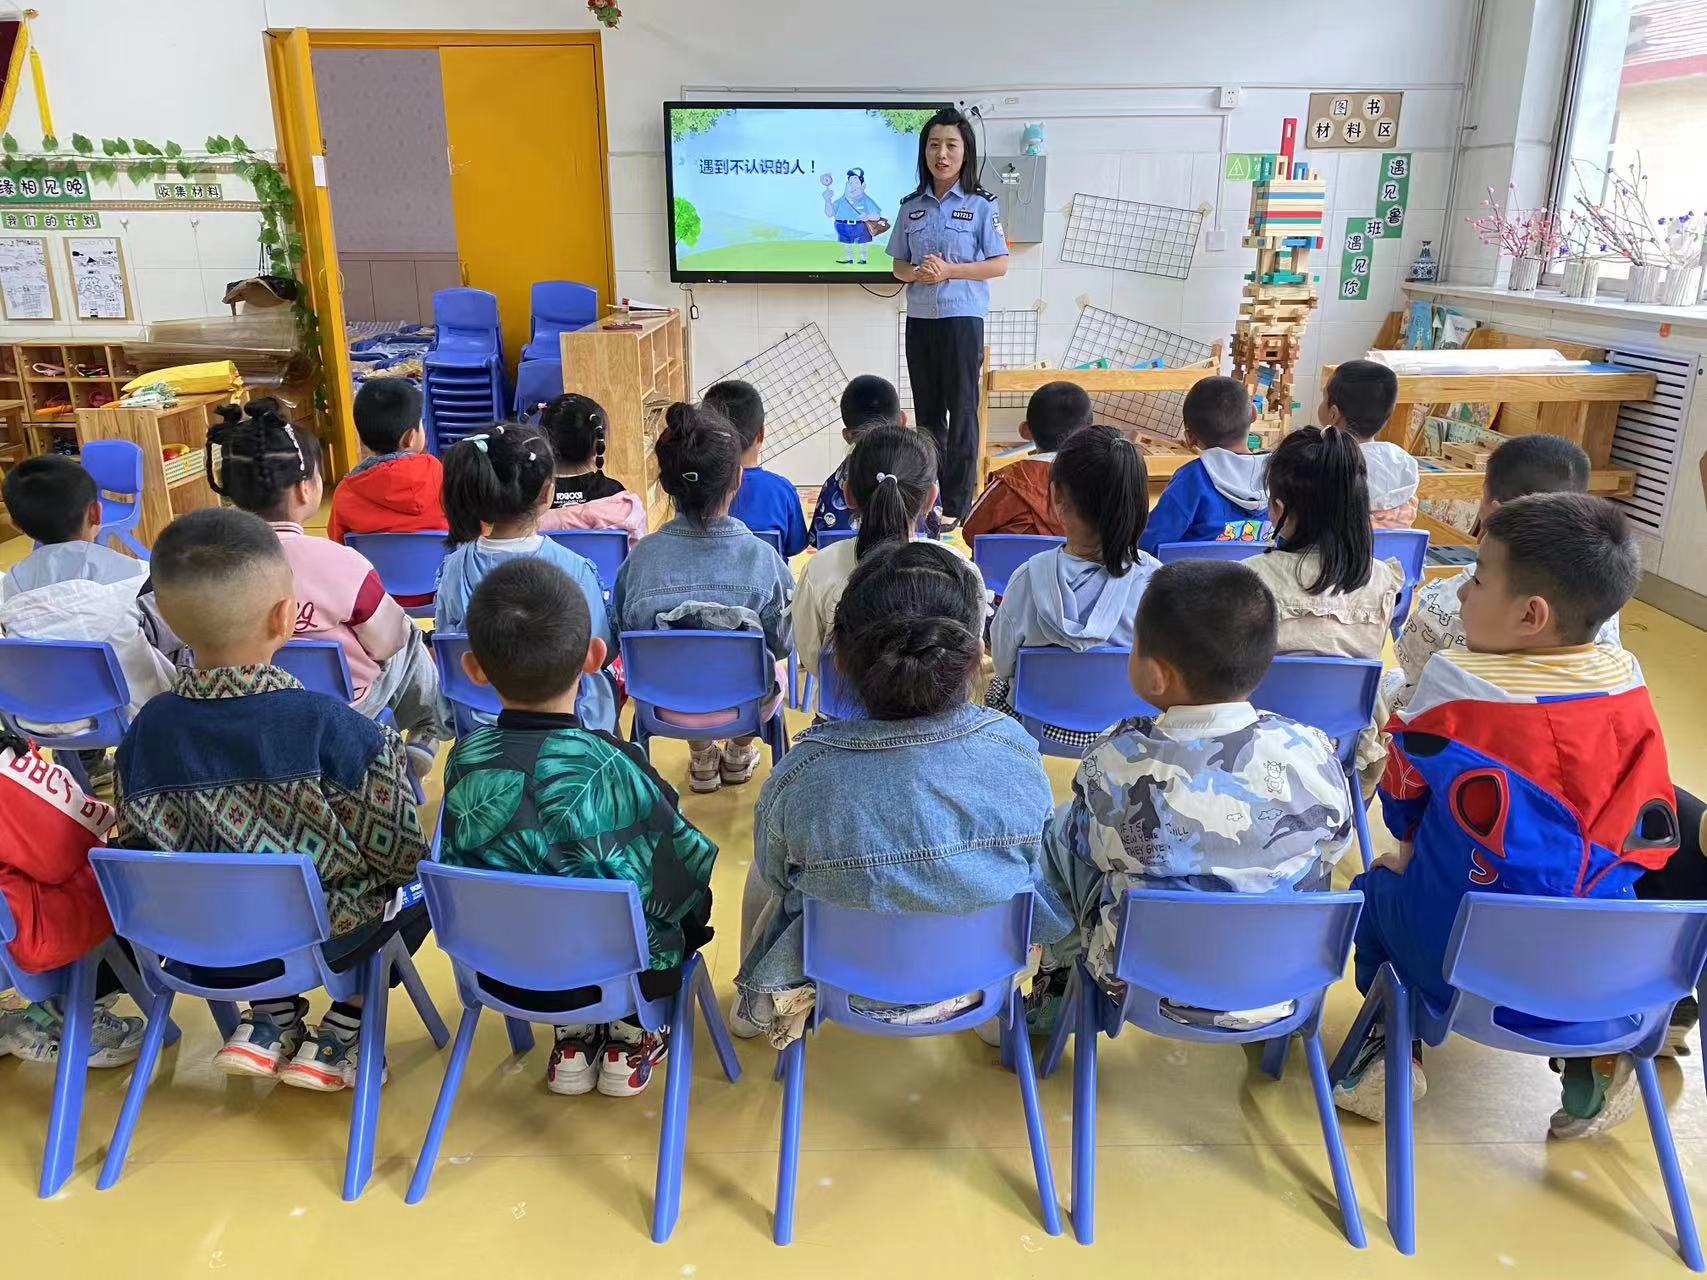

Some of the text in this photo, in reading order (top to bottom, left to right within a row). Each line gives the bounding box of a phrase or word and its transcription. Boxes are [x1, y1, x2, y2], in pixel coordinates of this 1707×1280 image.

[1333, 98, 1381, 116] 图书
[1315, 121, 1392, 138] 材料区
[699, 158, 815, 175] 遇到不认识的人！
[158, 185, 219, 198] 收集材料
[1367, 159, 1405, 236] 遇见鲁班
[7, 214, 96, 227] 我们的计划
[1345, 235, 1368, 295] 遇见你
